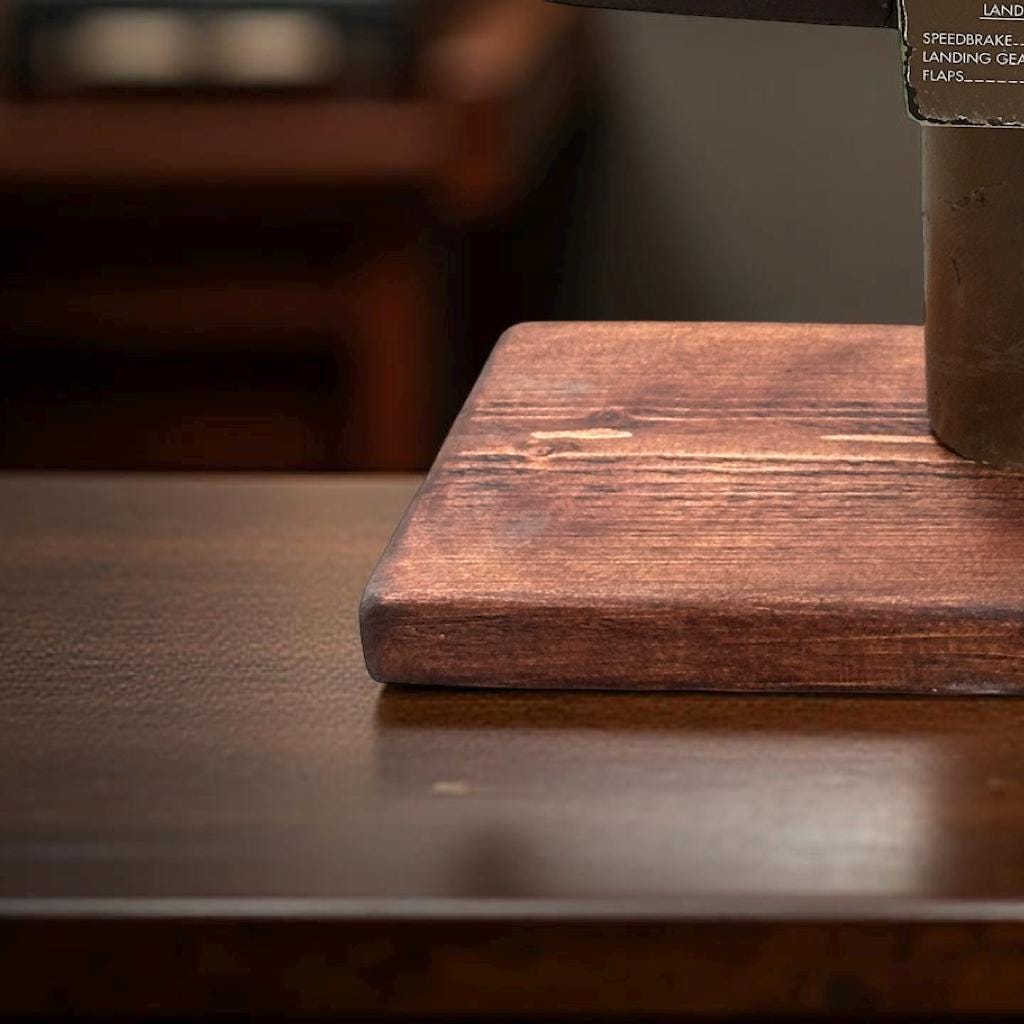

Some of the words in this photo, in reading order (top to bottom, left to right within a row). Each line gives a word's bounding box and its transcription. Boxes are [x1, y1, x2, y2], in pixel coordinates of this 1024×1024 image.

[922, 32, 1013, 47] SPEEDBRAKE
[922, 51, 991, 65] LANDING
[922, 70, 964, 82] FLAPS
